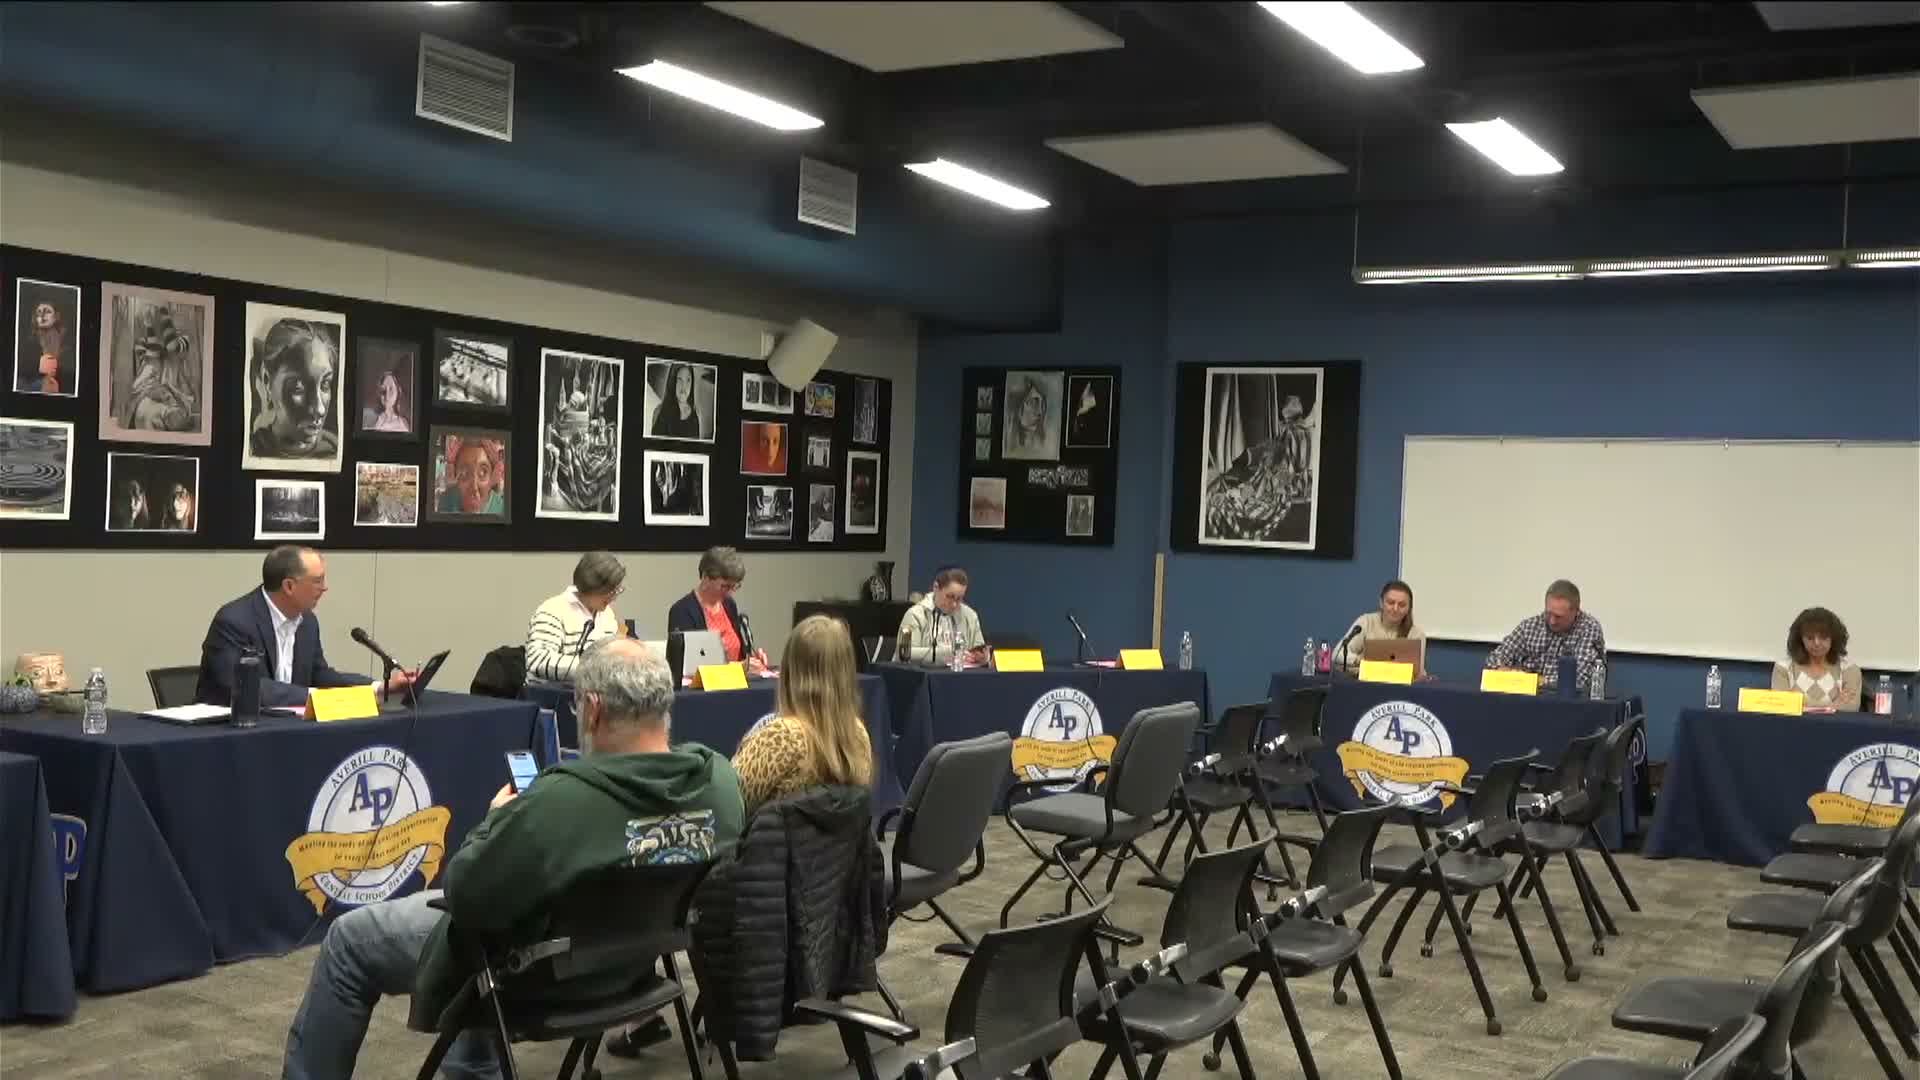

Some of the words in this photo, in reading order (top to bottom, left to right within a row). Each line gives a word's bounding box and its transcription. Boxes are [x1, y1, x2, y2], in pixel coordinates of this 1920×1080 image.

[1037, 690, 1068, 710] AVERILL
[1072, 690, 1091, 709] PARK
[1370, 704, 1407, 721] AVERILL
[1415, 706, 1437, 729] PARK
[1048, 703, 1077, 740] AP
[1384, 714, 1421, 755] AP
[331, 751, 376, 788] AVERILL
[383, 749, 409, 773] PARK
[1849, 746, 1894, 766] AVERILL
[348, 772, 393, 827] AP
[1868, 759, 1917, 804] AP
[387, 853, 419, 890] DISTRICT
